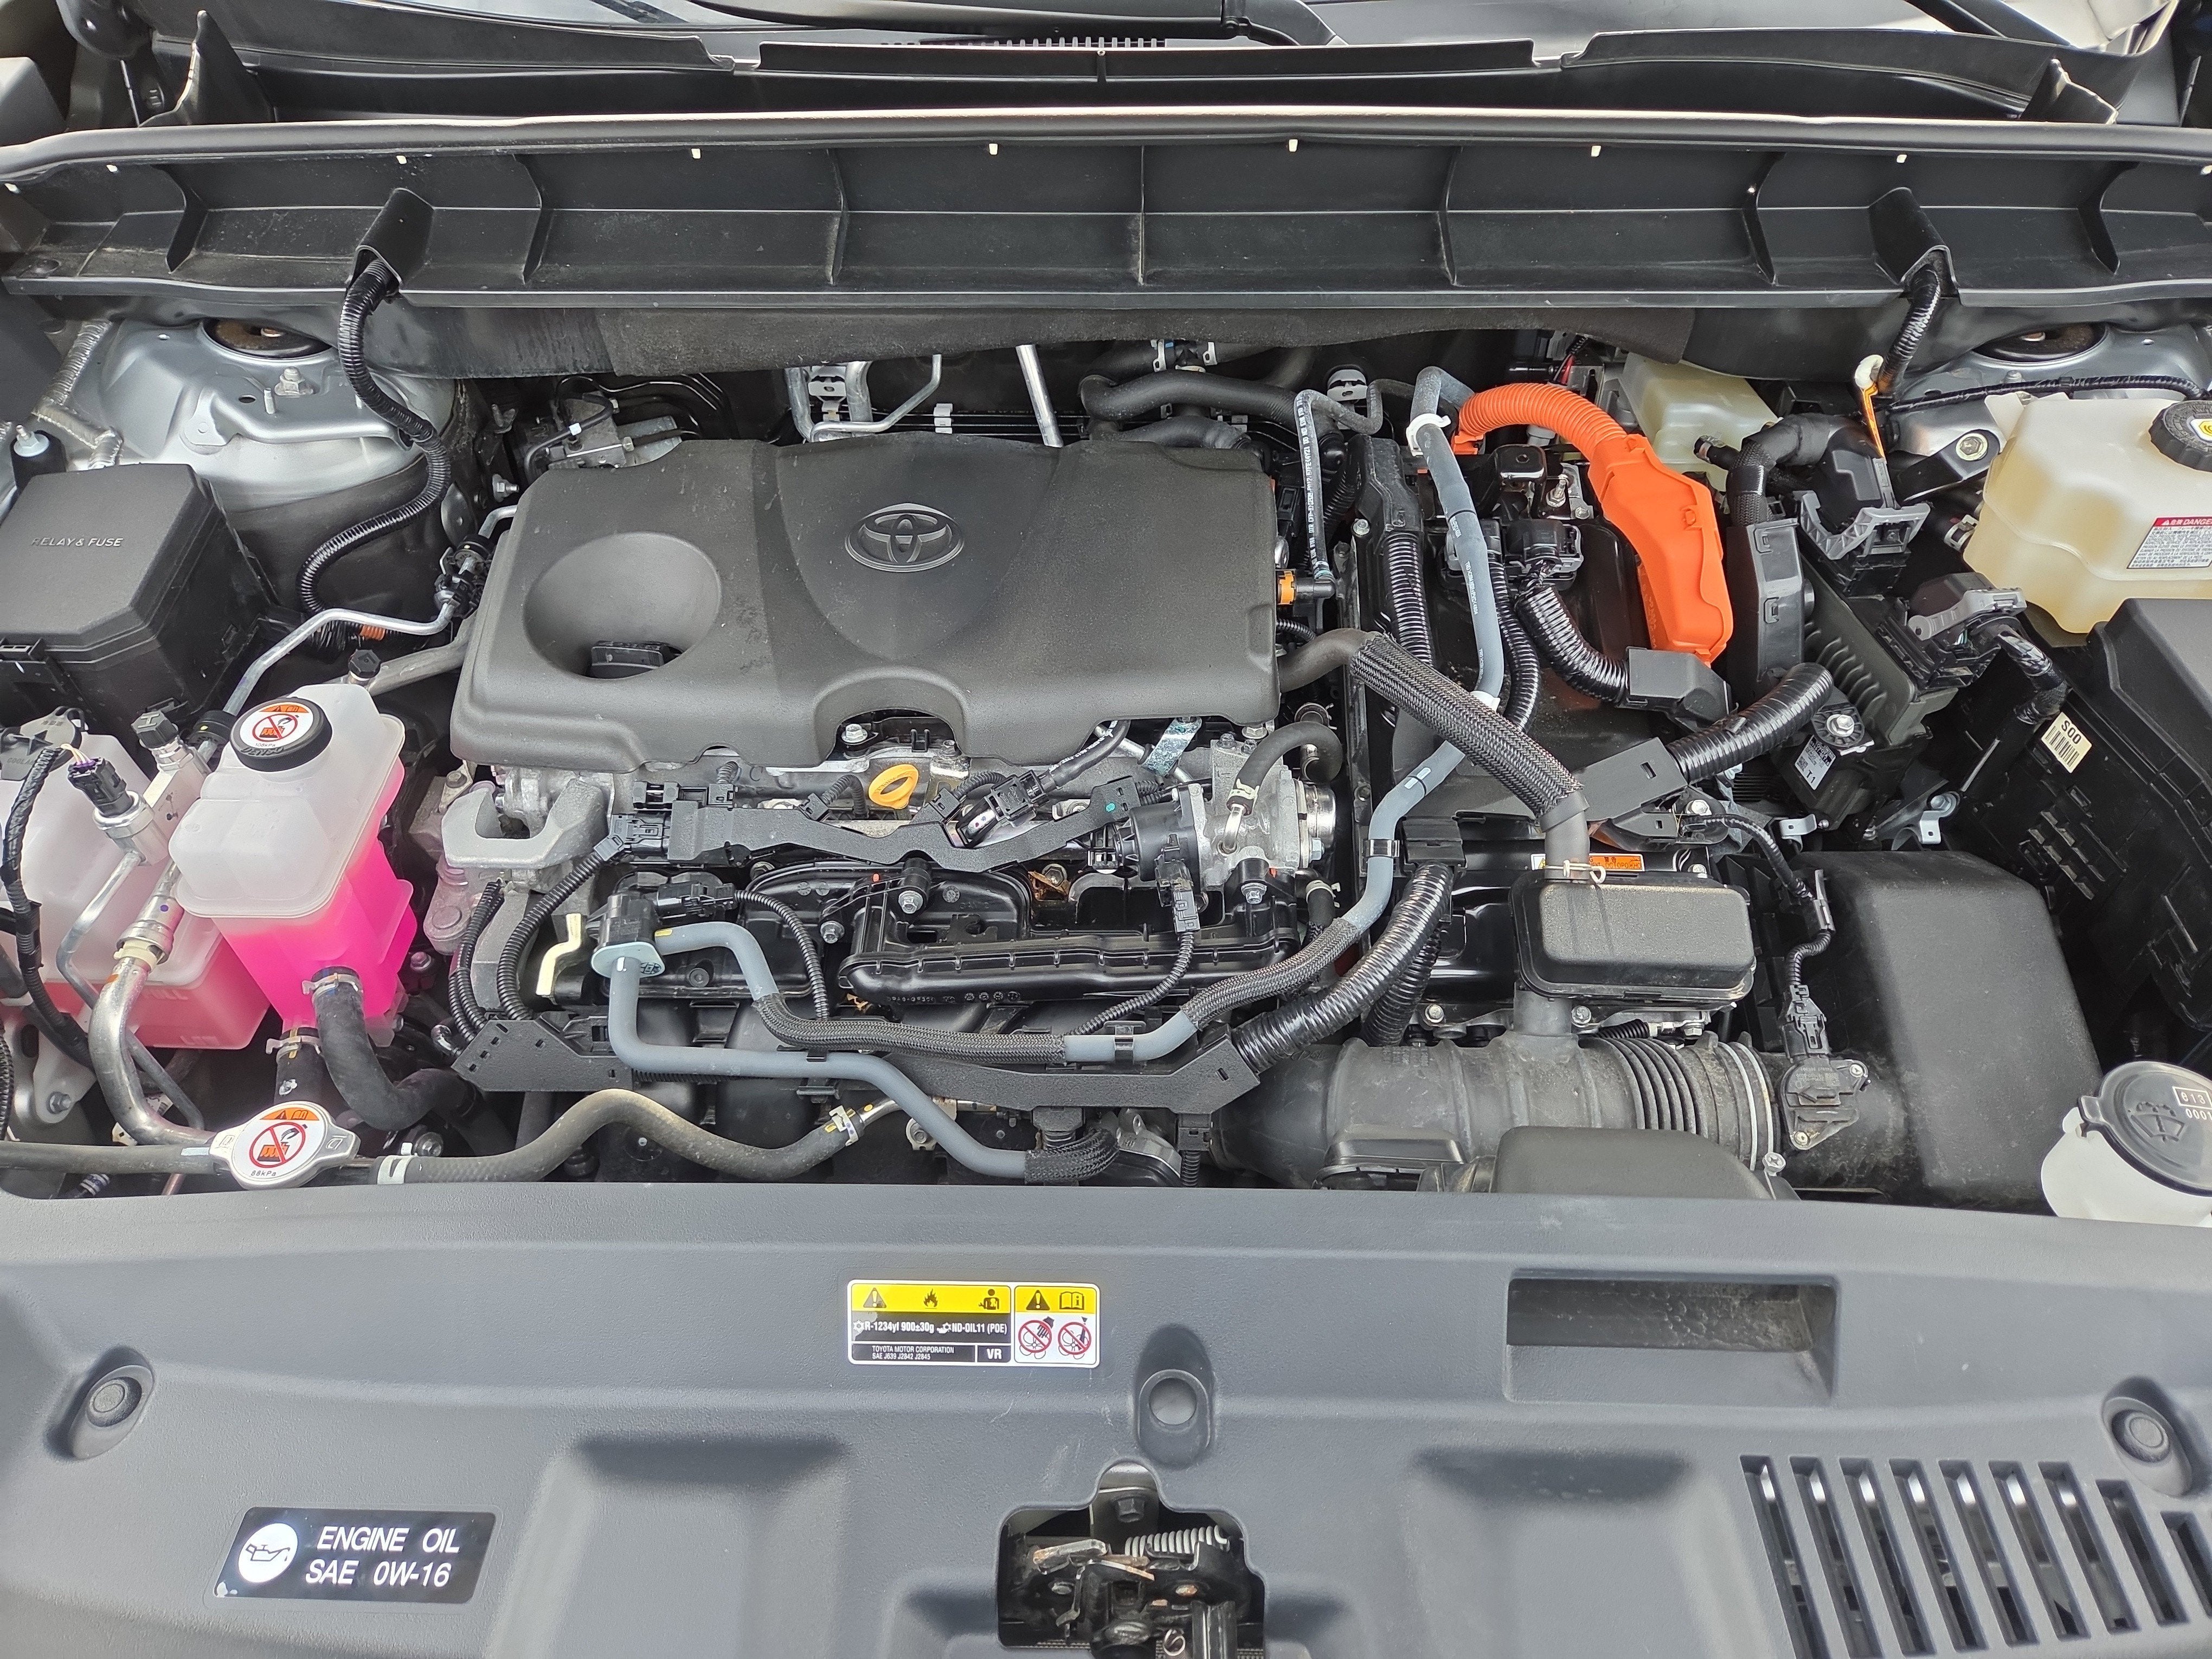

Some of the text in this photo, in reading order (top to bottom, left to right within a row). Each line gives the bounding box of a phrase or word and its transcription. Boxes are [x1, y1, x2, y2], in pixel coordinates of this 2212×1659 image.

[31, 537, 76, 546] RELAY
[87, 538, 124, 546] FUSE
[240, 747, 285, 756] DENSO
[901, 1322, 935, 1334] 900±30g
[951, 1322, 985, 1333] ND-OIL11
[987, 1323, 1007, 1335] (POE)
[915, 1346, 954, 1354] CORPORATION
[986, 1348, 1002, 1360] VR
[316, 1526, 461, 1554] ENGINE OIL
[305, 1559, 452, 1587] SAE 0W-16
